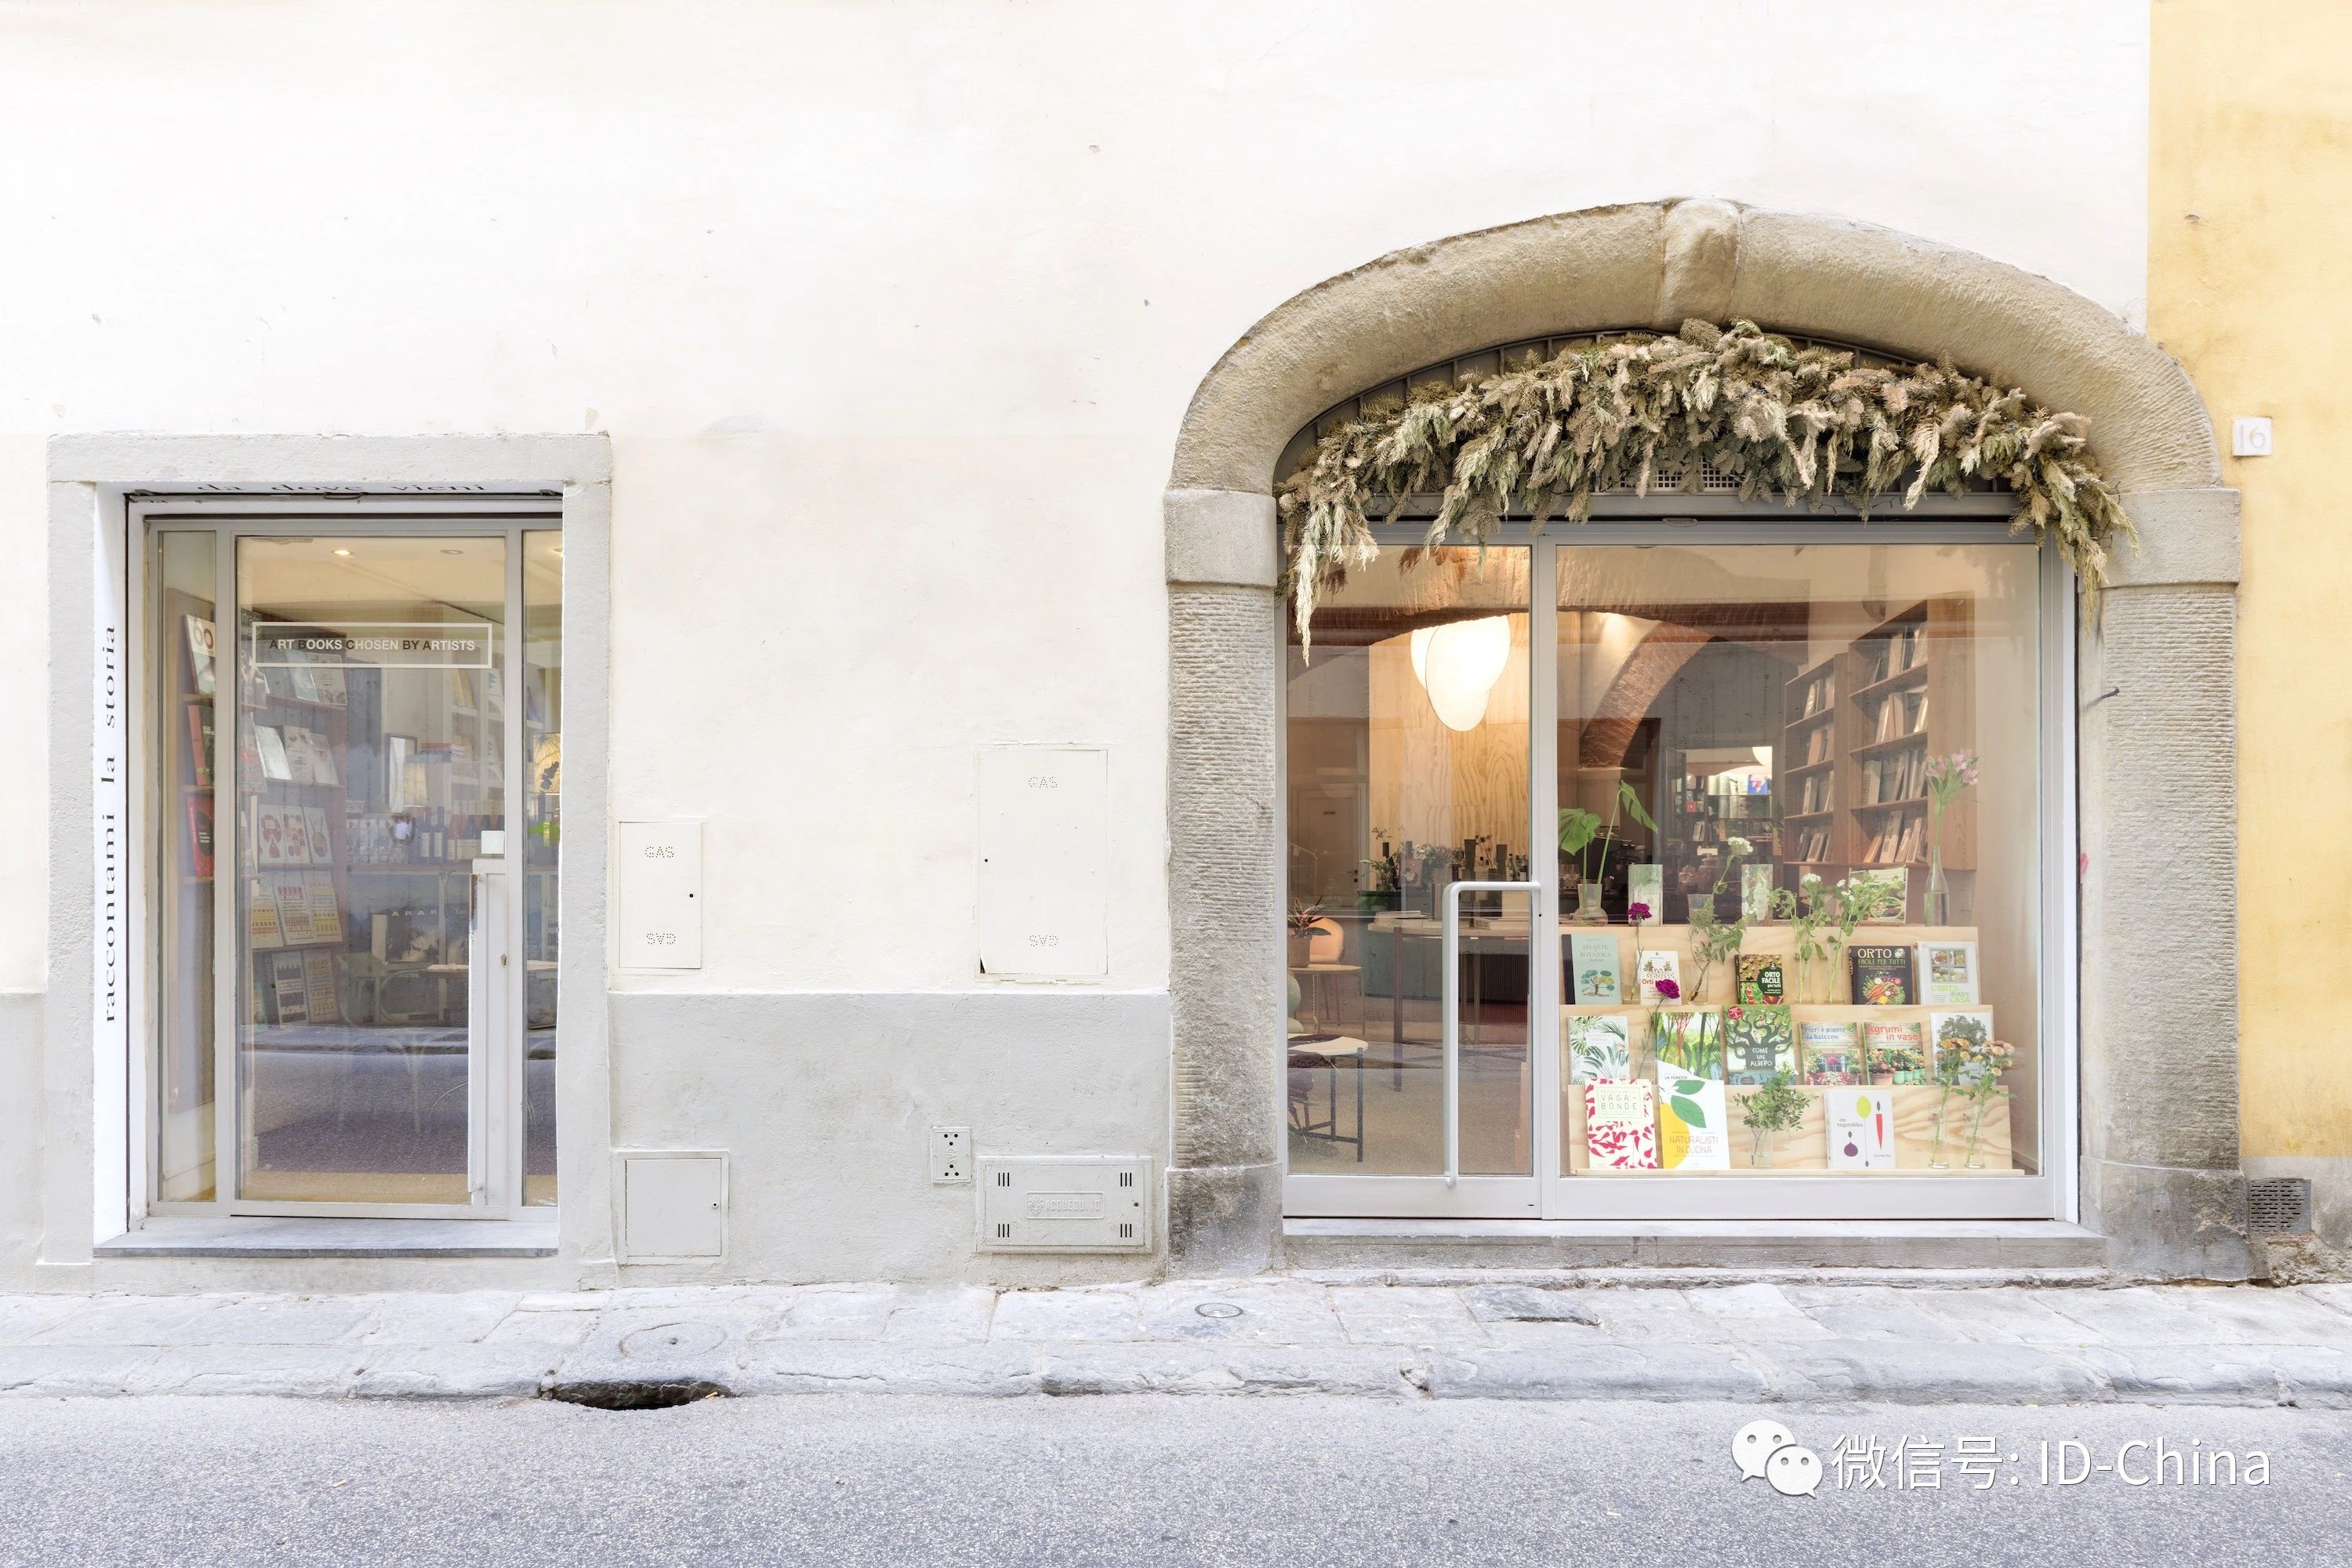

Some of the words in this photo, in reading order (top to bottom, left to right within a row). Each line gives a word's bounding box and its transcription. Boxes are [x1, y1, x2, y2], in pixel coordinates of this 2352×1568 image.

[269, 639, 294, 650] ART
[298, 639, 343, 651] BOOKS
[346, 640, 399, 651] CHOSEN
[402, 640, 420, 651] BY
[422, 640, 476, 652] ARTISTS
[101, 625, 116, 729] storia
[100, 753, 116, 786] la
[1028, 775, 1058, 788] GAS
[644, 846, 675, 858] GAS
[102, 812, 116, 1022] raccontami
[646, 932, 676, 945] GAS
[1857, 948, 1892, 958] ORTO
[1867, 1025, 1903, 1035] Agrumi
[1669, 1135, 1719, 1145] NATURALISTI
[1686, 1145, 1713, 1153] CUCINA
